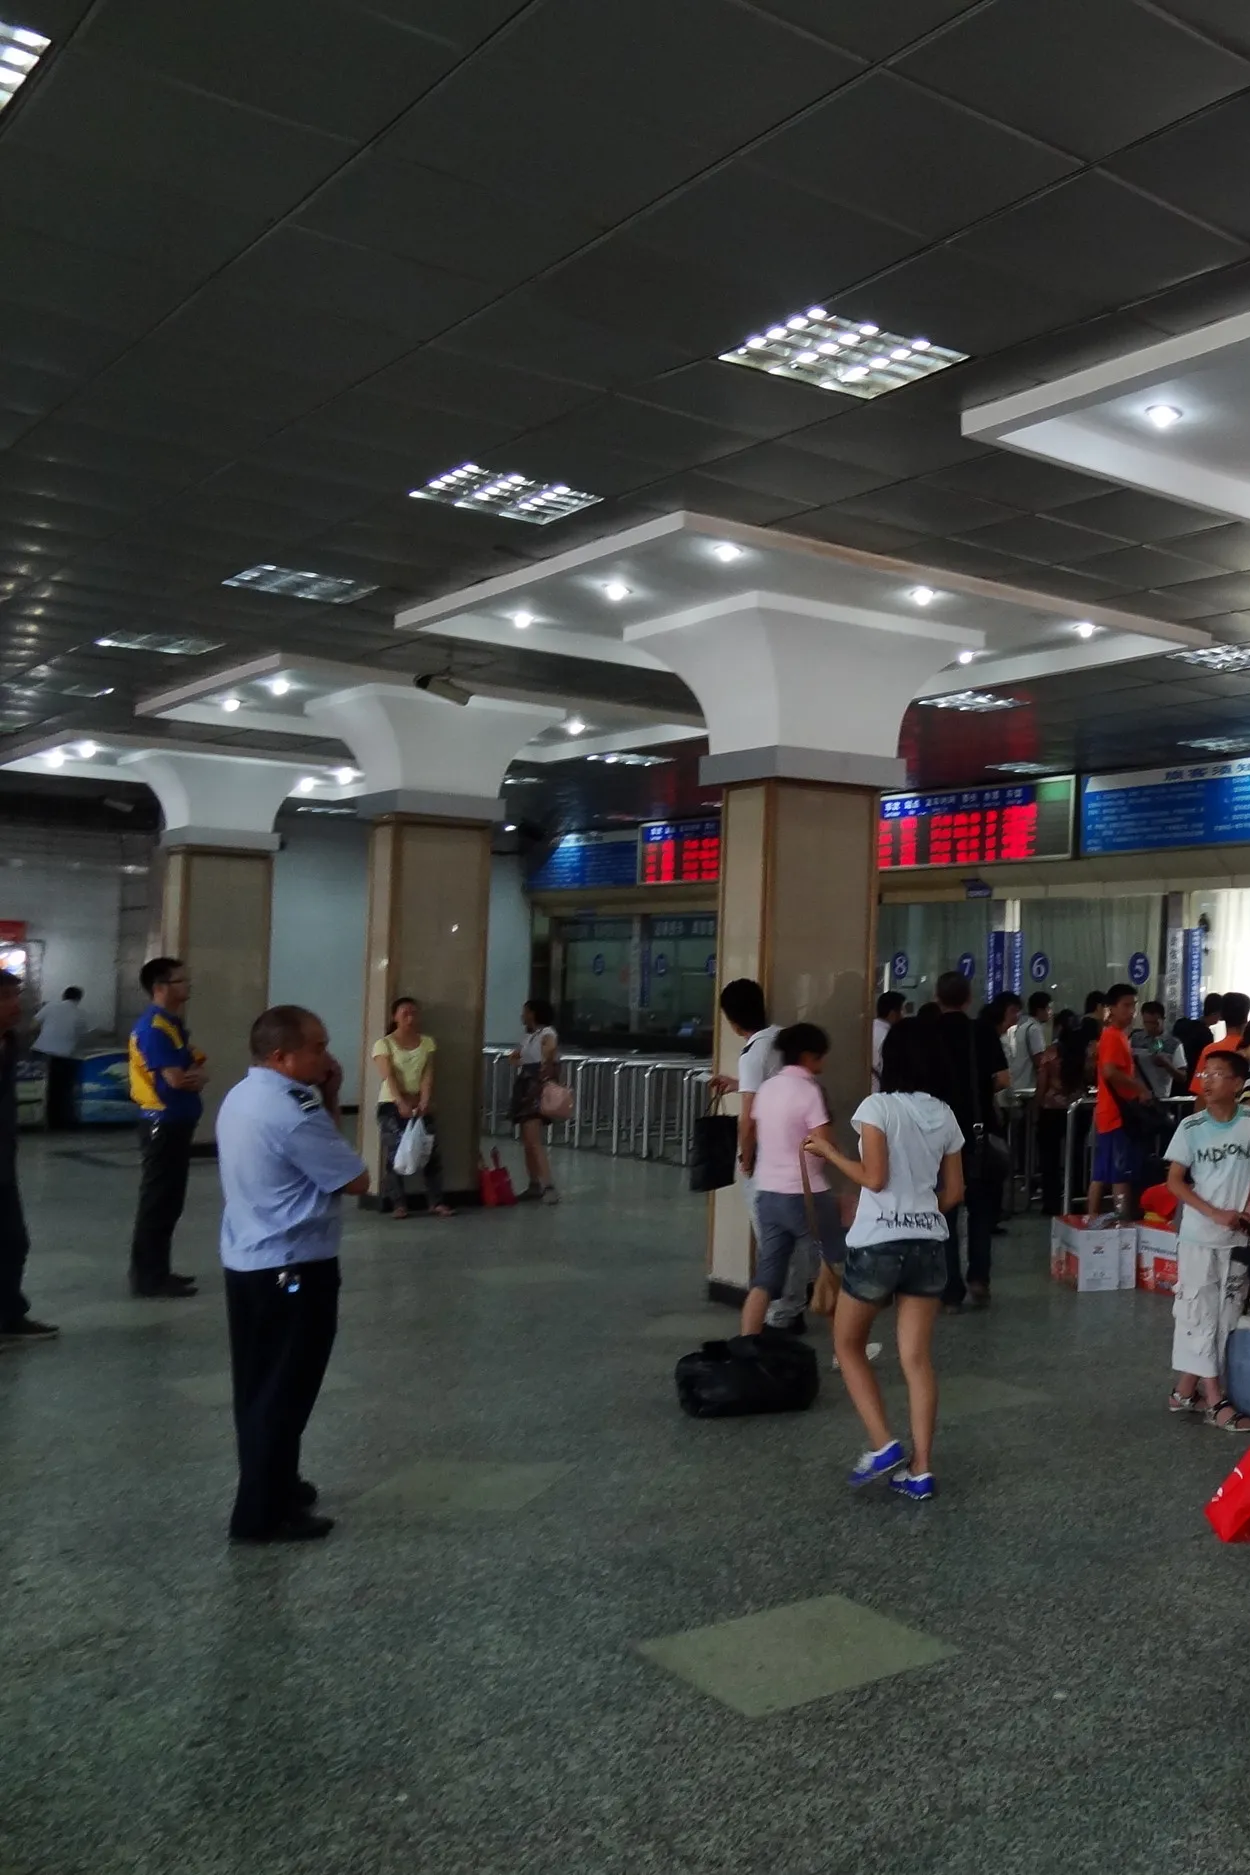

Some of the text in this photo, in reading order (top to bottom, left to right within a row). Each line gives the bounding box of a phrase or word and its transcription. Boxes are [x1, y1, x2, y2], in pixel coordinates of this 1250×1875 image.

[894, 956, 907, 971] 8
[962, 958, 973, 976] 7
[1032, 956, 1046, 978] 6
[1133, 958, 1145, 978] 5
